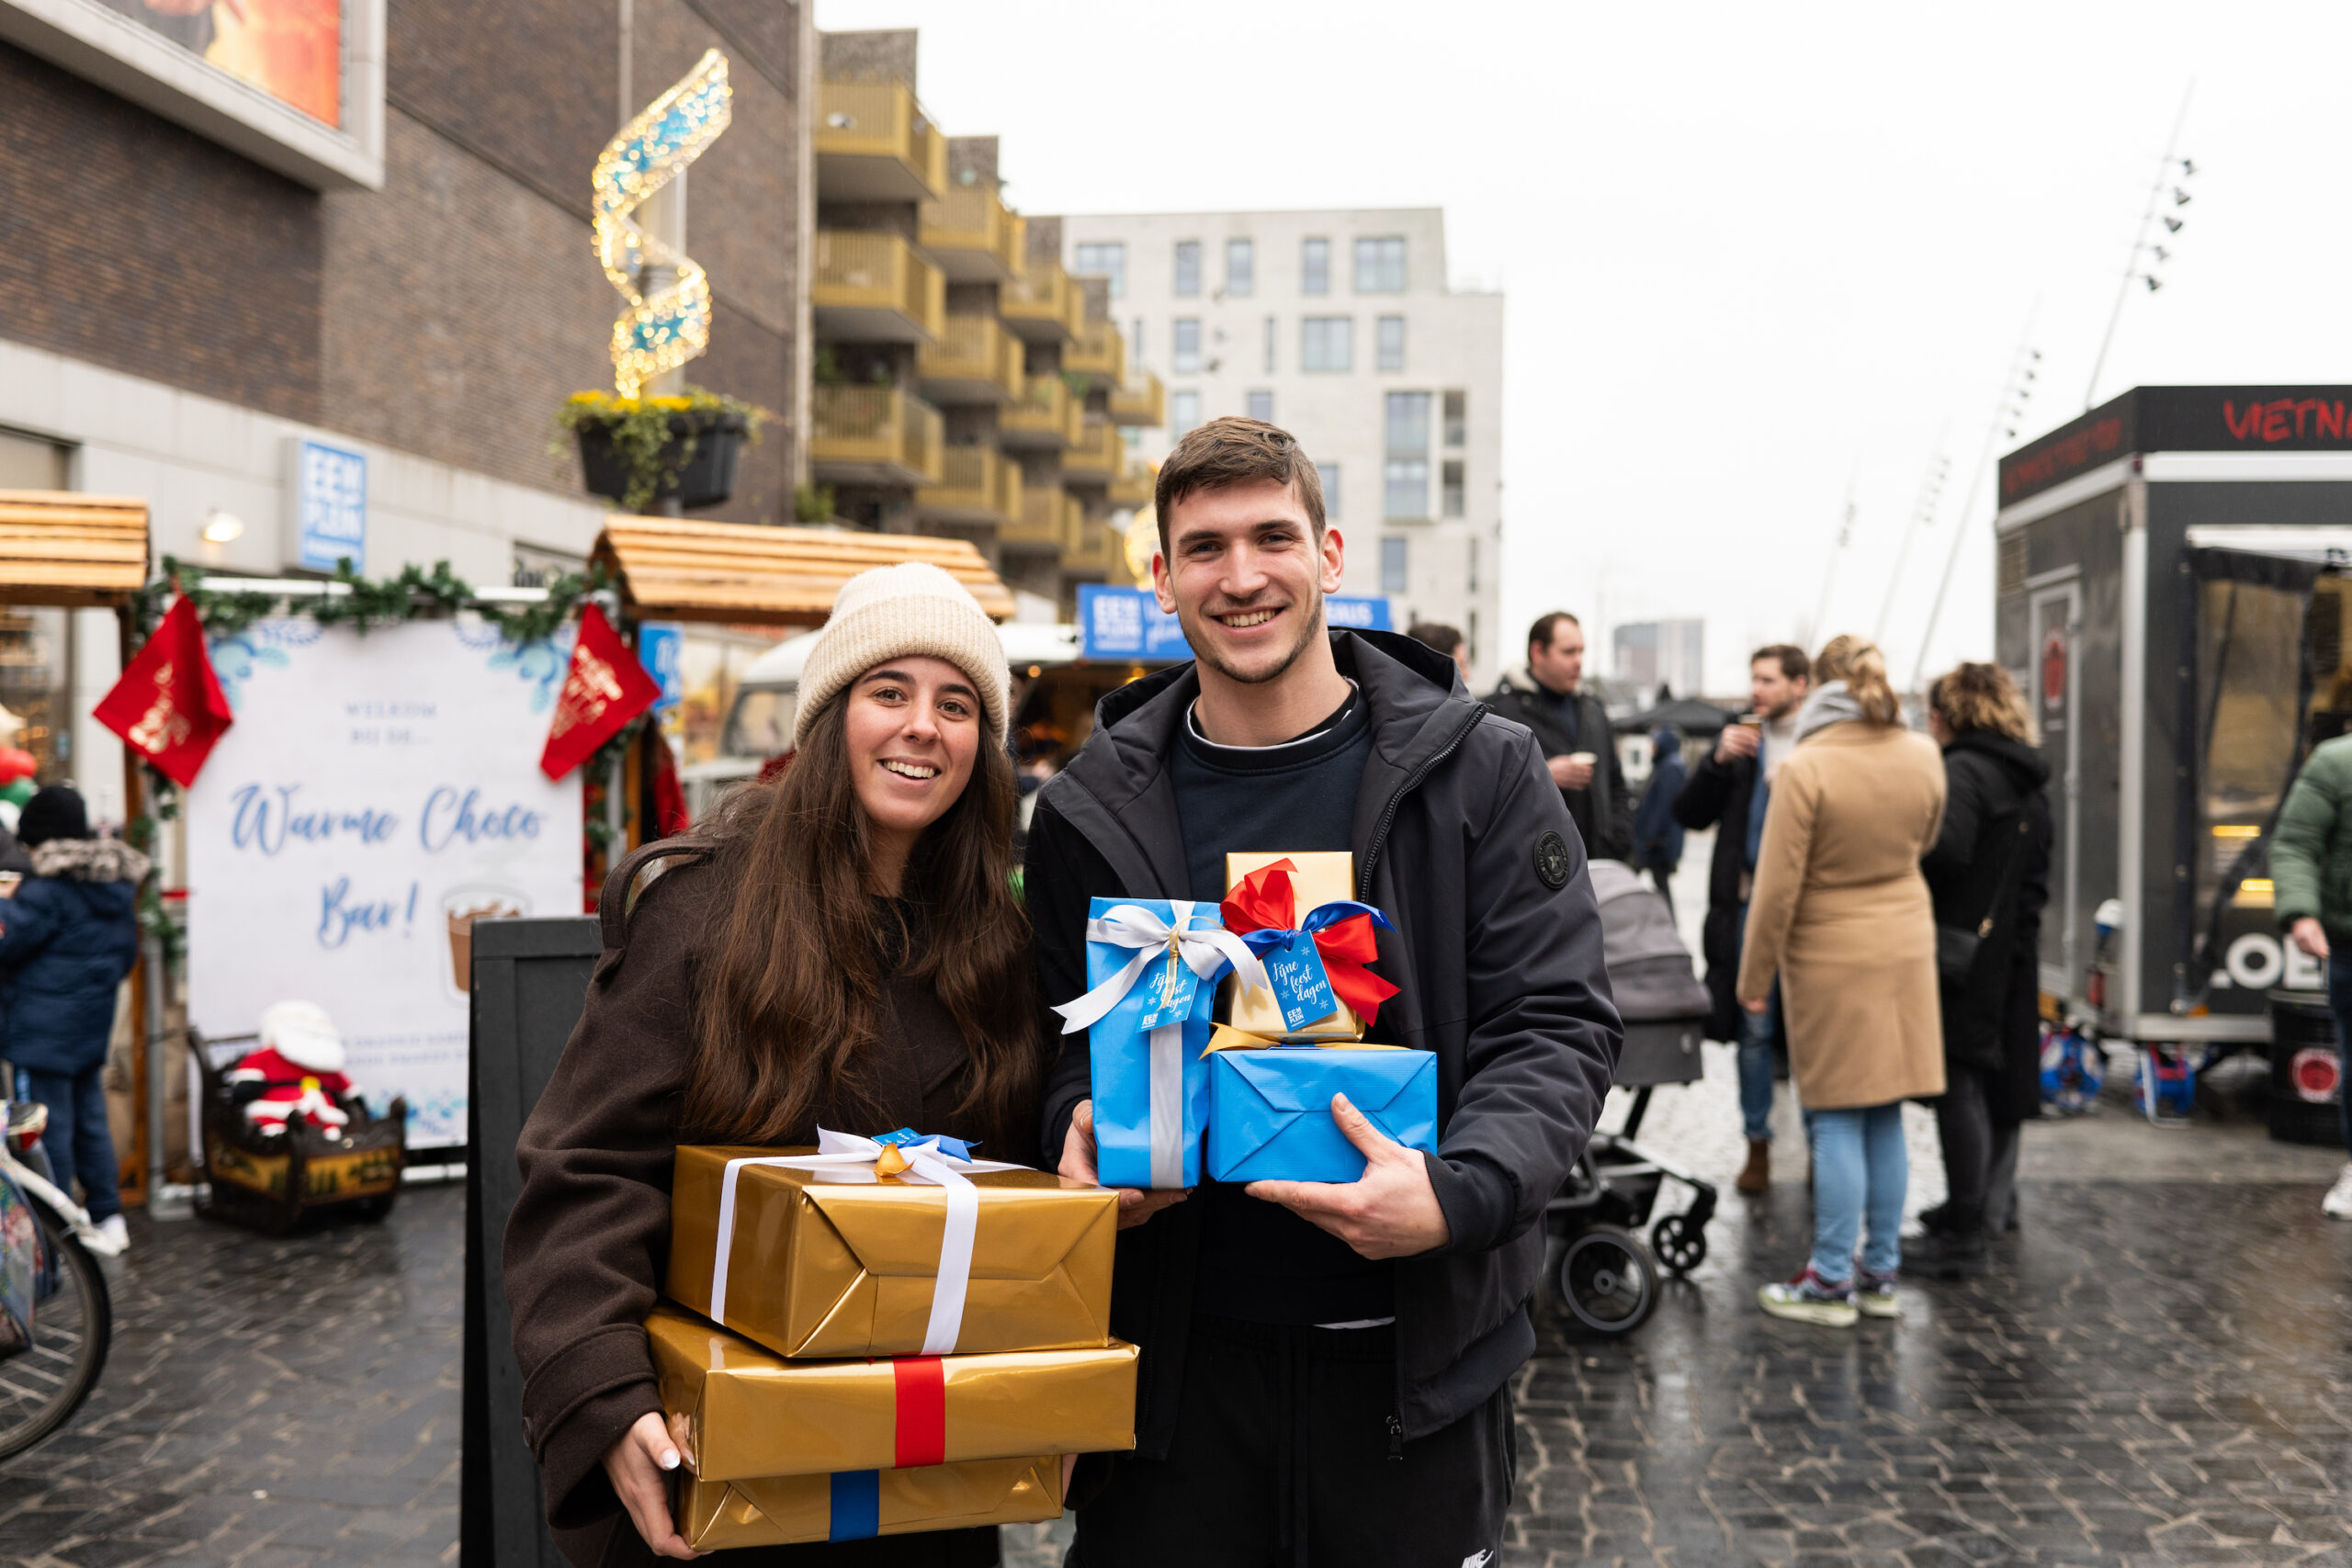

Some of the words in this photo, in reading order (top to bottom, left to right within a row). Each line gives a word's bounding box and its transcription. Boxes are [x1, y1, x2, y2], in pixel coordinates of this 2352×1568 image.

[2222, 398, 2352, 443] VIETN
[230, 783, 399, 856] Warme
[419, 784, 547, 853] Choco
[316, 875, 419, 950] Bar!
[1272, 961, 1298, 987] Fijne
[1290, 964, 1312, 994] feest
[1296, 979, 1327, 1005] dagen
[1286, 1006, 1302, 1019] EEM
